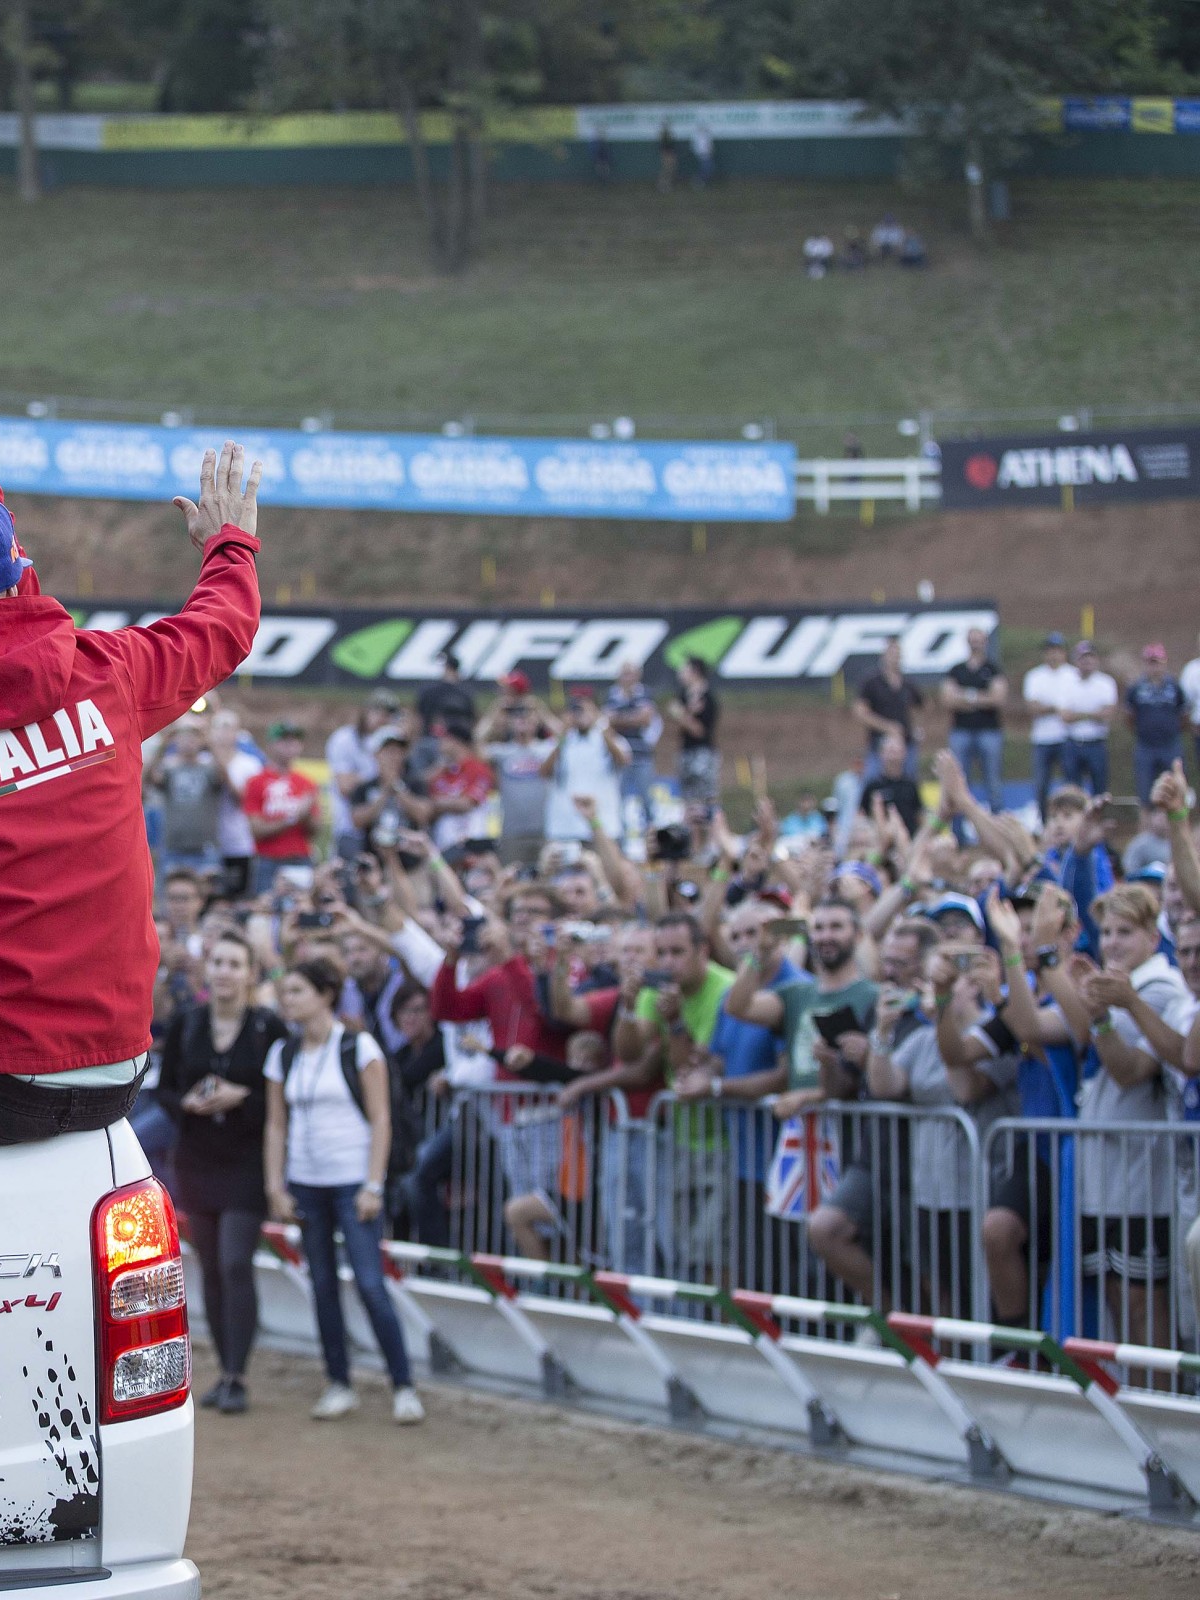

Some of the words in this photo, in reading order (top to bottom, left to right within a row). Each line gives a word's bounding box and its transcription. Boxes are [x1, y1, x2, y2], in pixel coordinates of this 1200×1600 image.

[997, 443, 1139, 488] ATHENA
[387, 617, 668, 681] UFO
[717, 609, 998, 677] UFO
